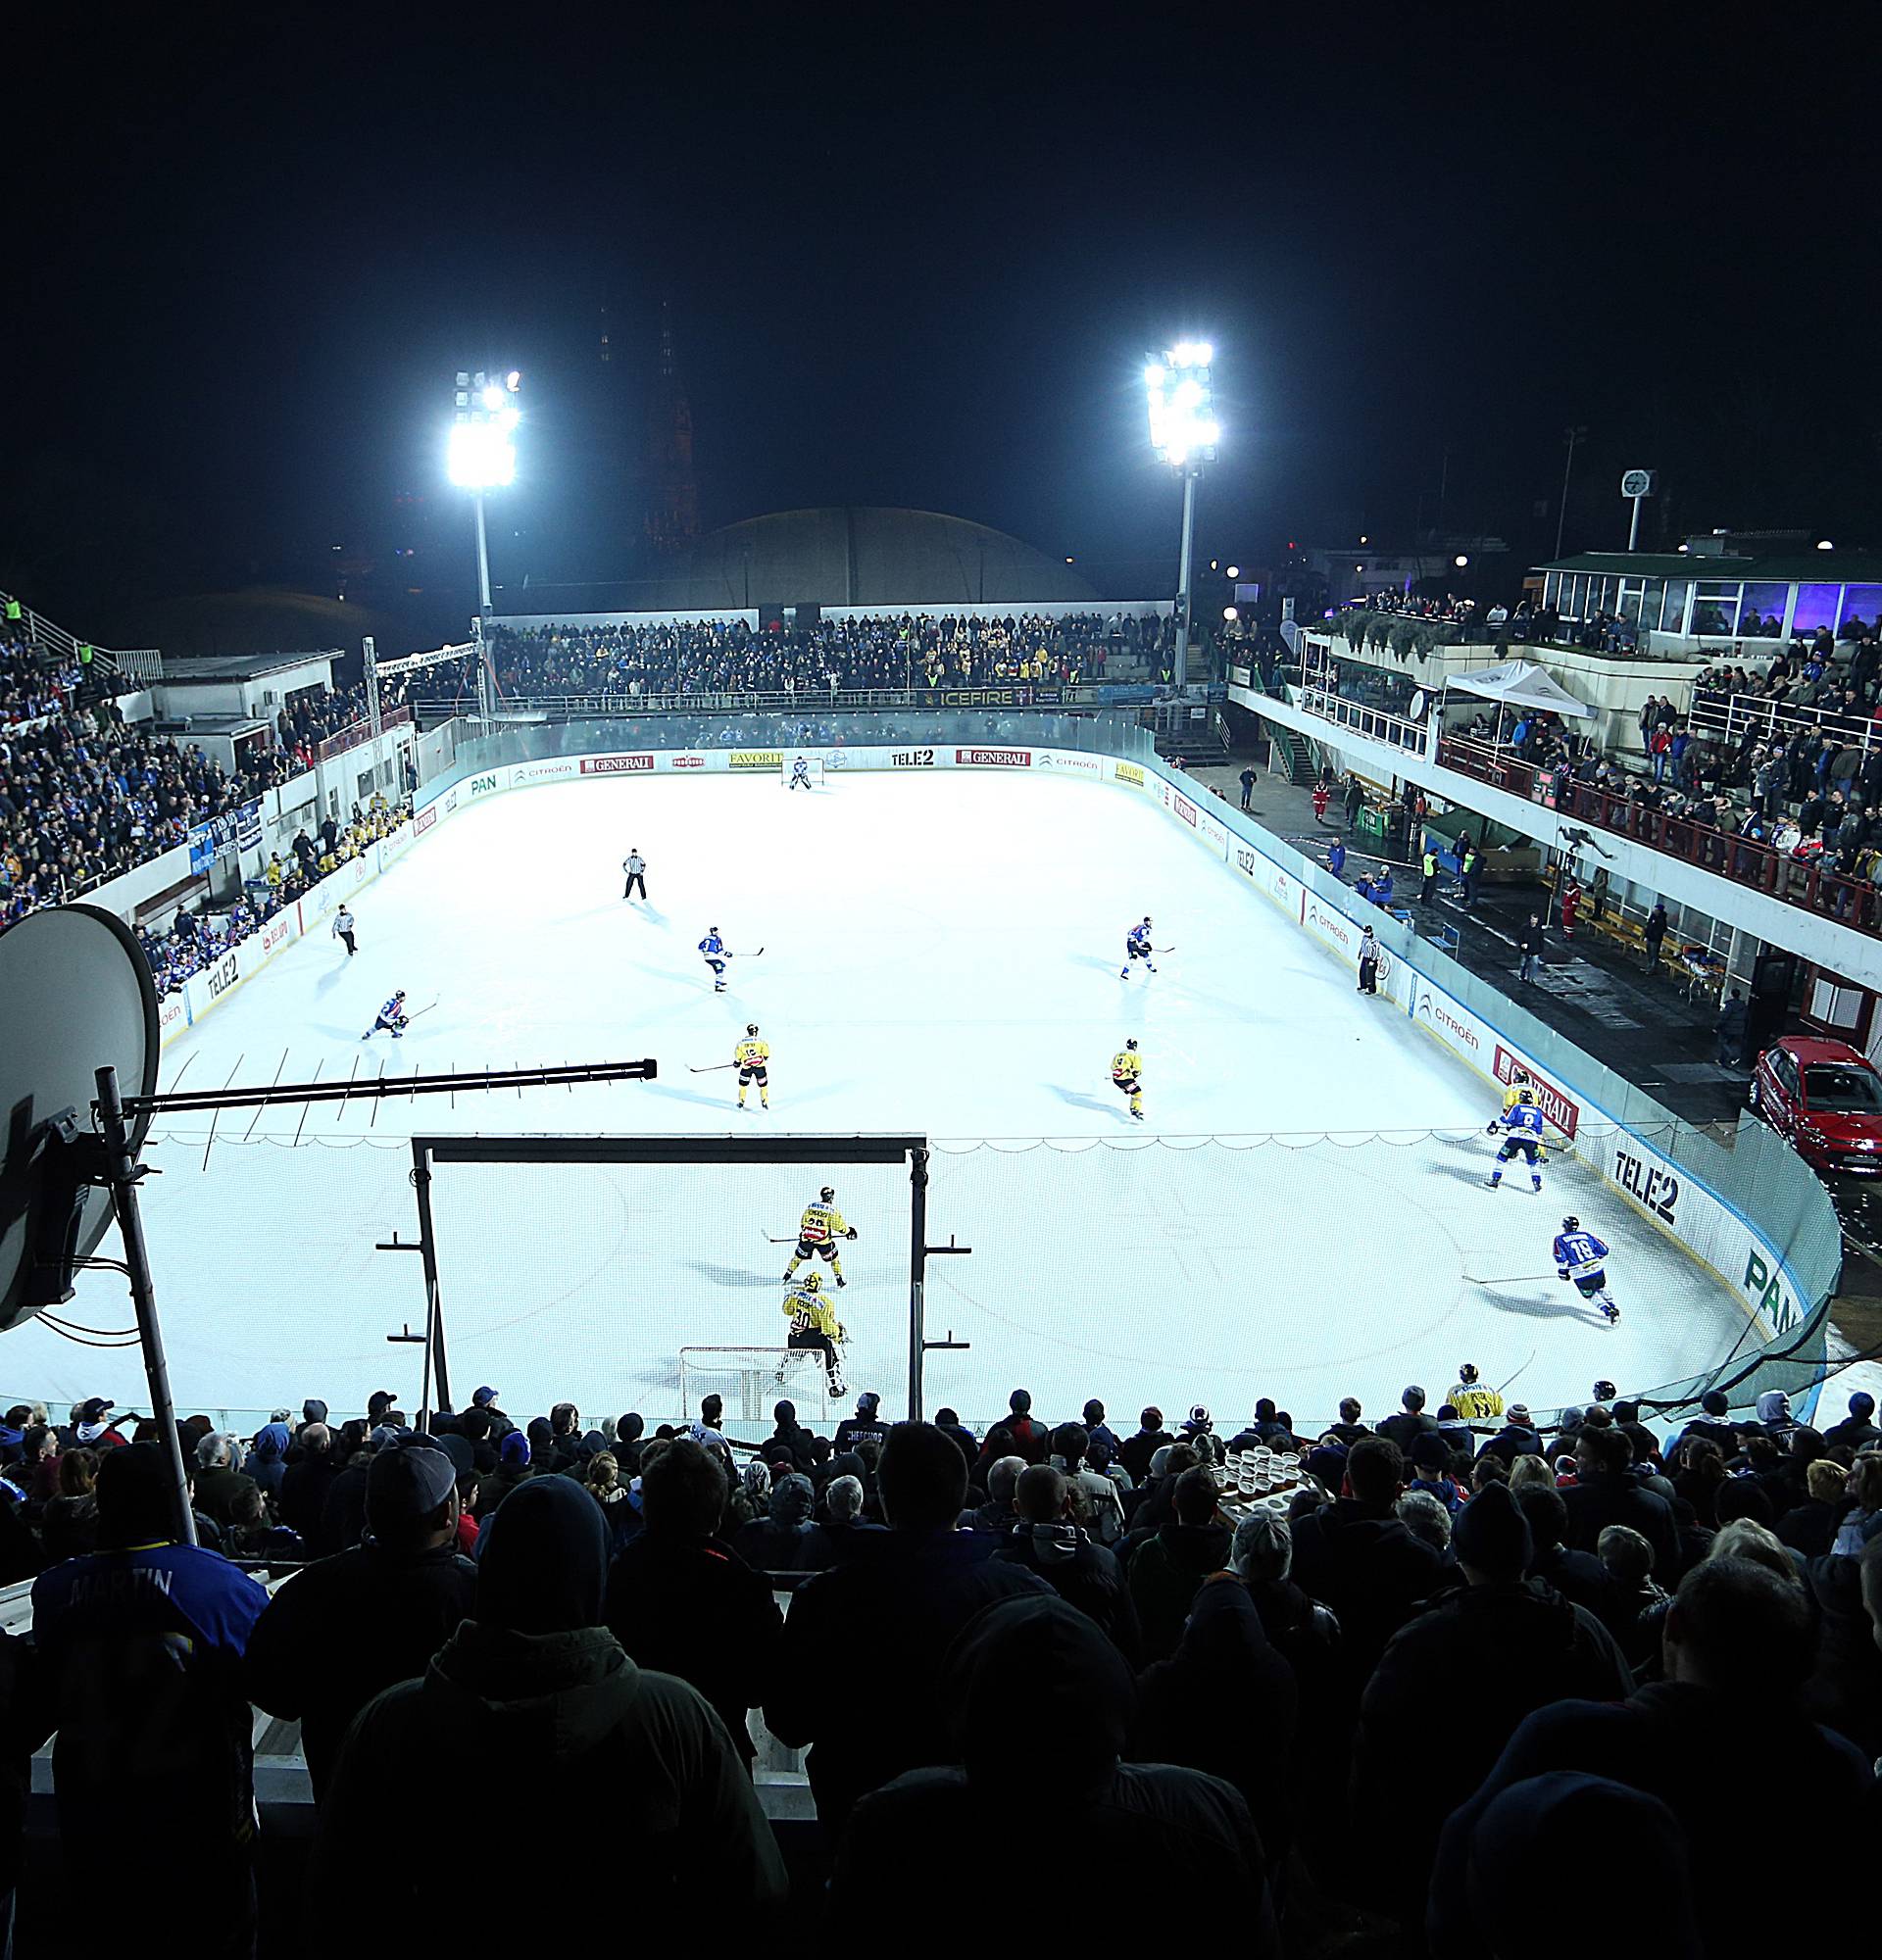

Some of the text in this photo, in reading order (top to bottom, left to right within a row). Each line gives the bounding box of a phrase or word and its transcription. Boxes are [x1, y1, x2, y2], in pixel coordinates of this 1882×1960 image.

[940, 691, 1013, 706] ICEFIRE
[596, 757, 650, 771] GENERALI
[730, 754, 783, 763] FAVORIT
[891, 749, 934, 766] TELE2
[972, 753, 1027, 765] GENERALI
[471, 775, 497, 796] PAN
[1237, 849, 1255, 877] TELE2
[1319, 914, 1349, 945] CITROËN
[208, 953, 239, 1000] TELE2
[1435, 1006, 1480, 1051] CITROËN
[1616, 1151, 1679, 1226] TELE2
[794, 1308, 811, 1328] 30
